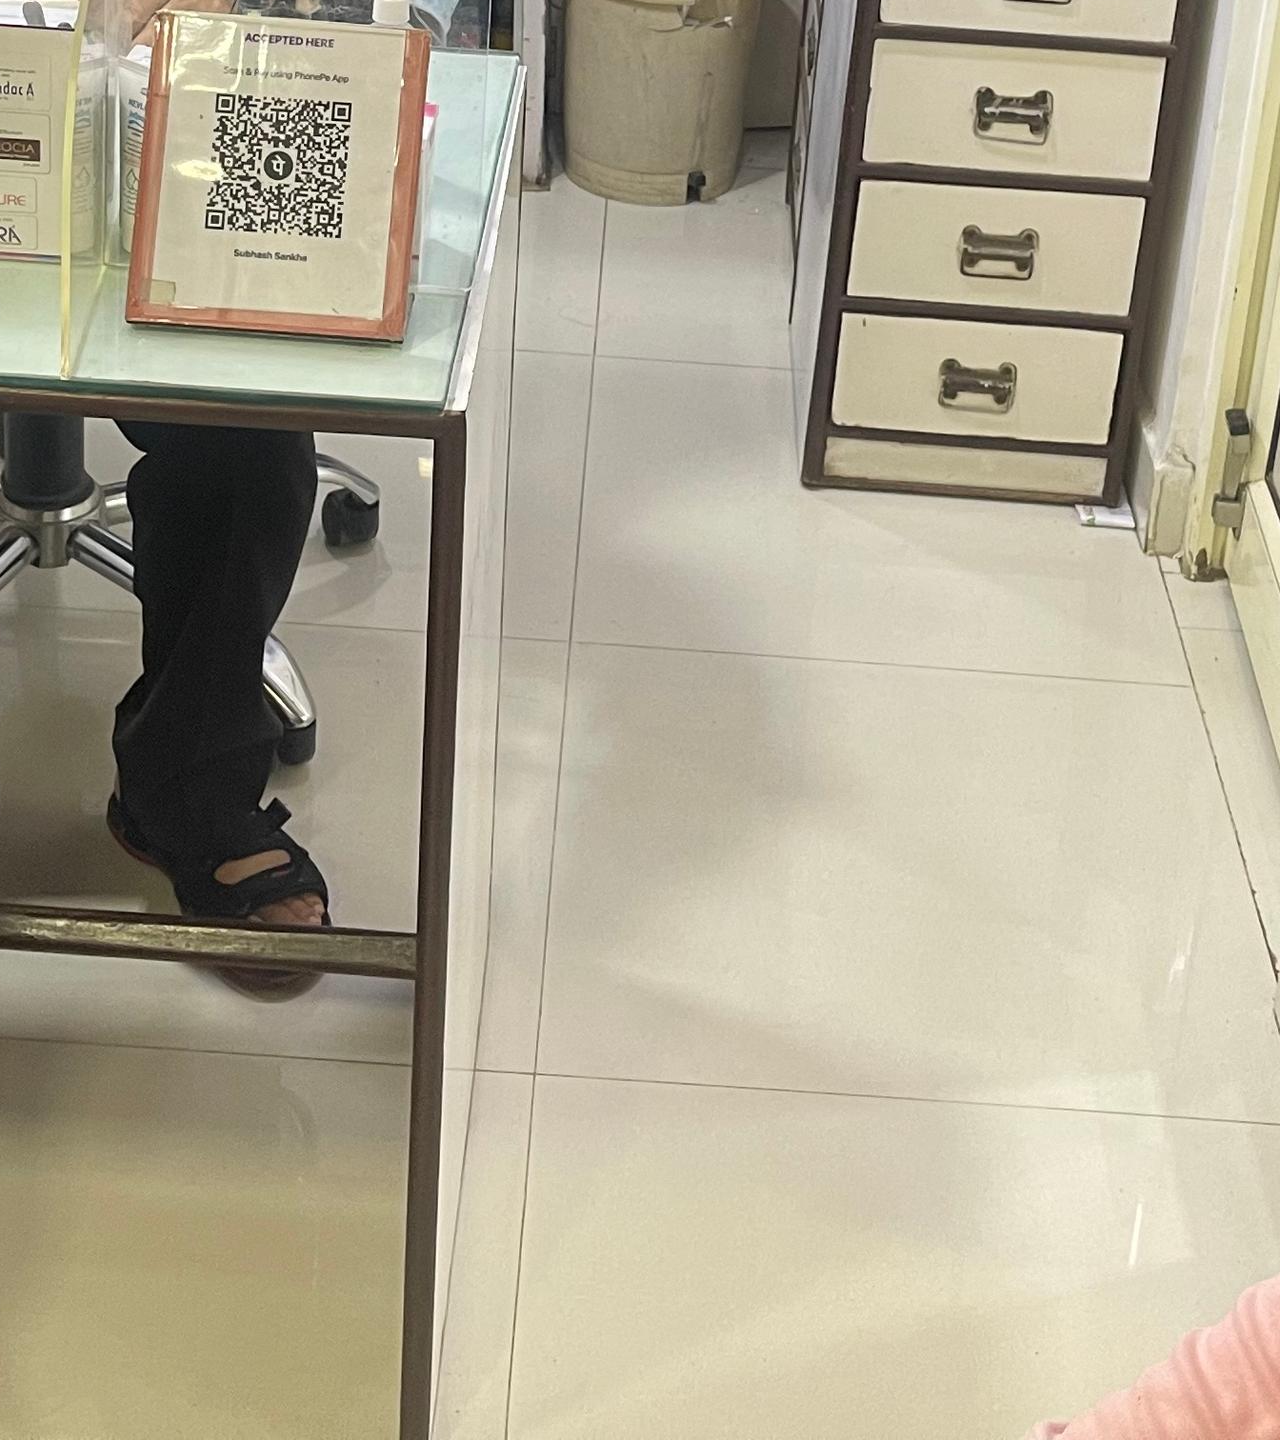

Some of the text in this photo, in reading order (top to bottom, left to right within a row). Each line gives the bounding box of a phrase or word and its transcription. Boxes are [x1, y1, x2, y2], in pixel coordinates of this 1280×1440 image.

[245, 32, 335, 48] ACCEPTED HERE
[26, 82, 35, 96] A
